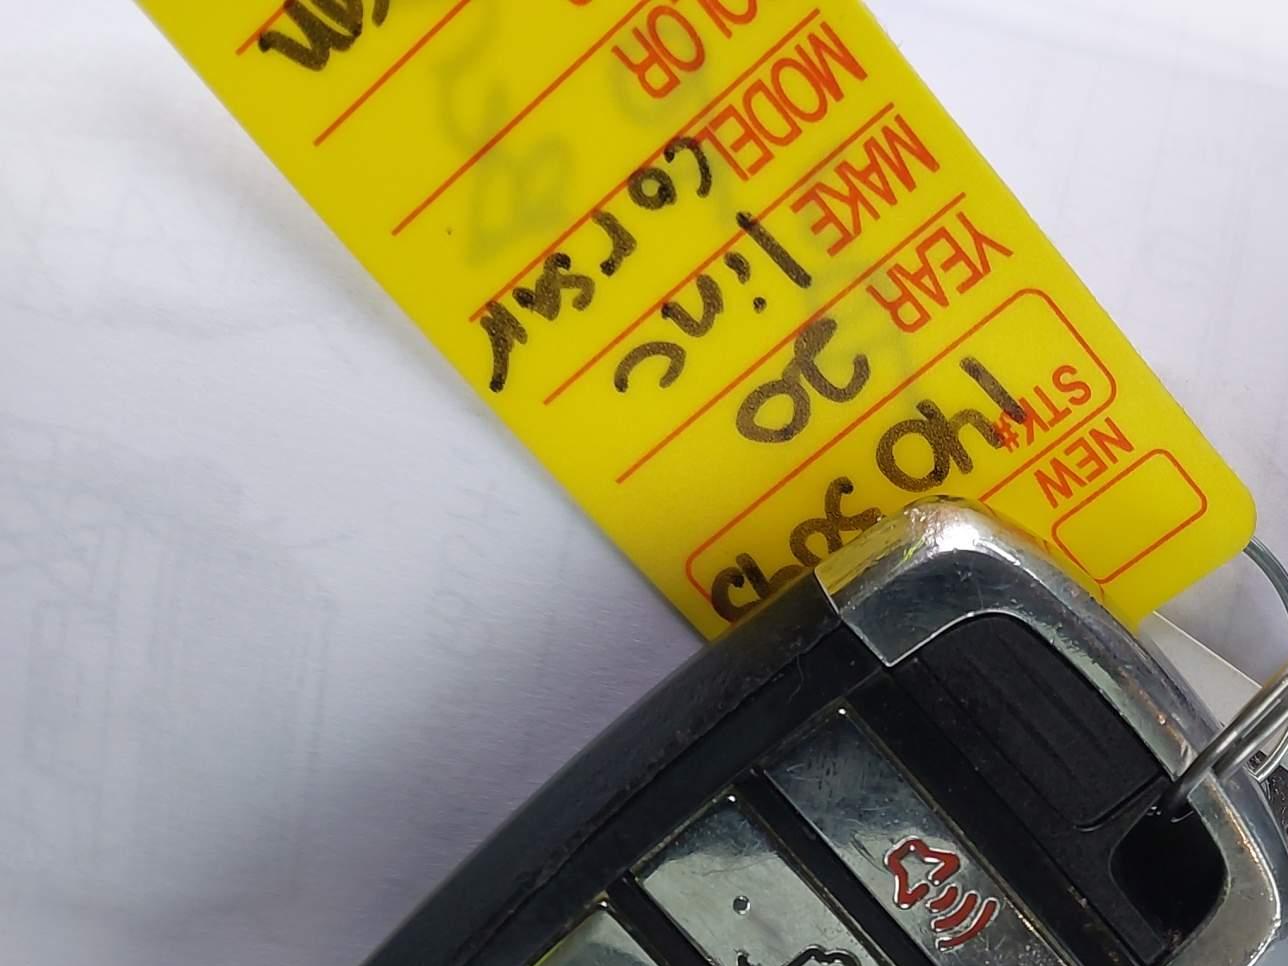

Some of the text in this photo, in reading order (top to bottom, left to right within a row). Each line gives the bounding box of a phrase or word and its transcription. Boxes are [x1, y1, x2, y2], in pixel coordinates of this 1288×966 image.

[697, 21, 867, 181] MODEL
[790, 114, 940, 257] MAKE
[866, 211, 1014, 333] YEAR
[736, 318, 871, 443] 20
[1034, 417, 1134, 508] NEW
